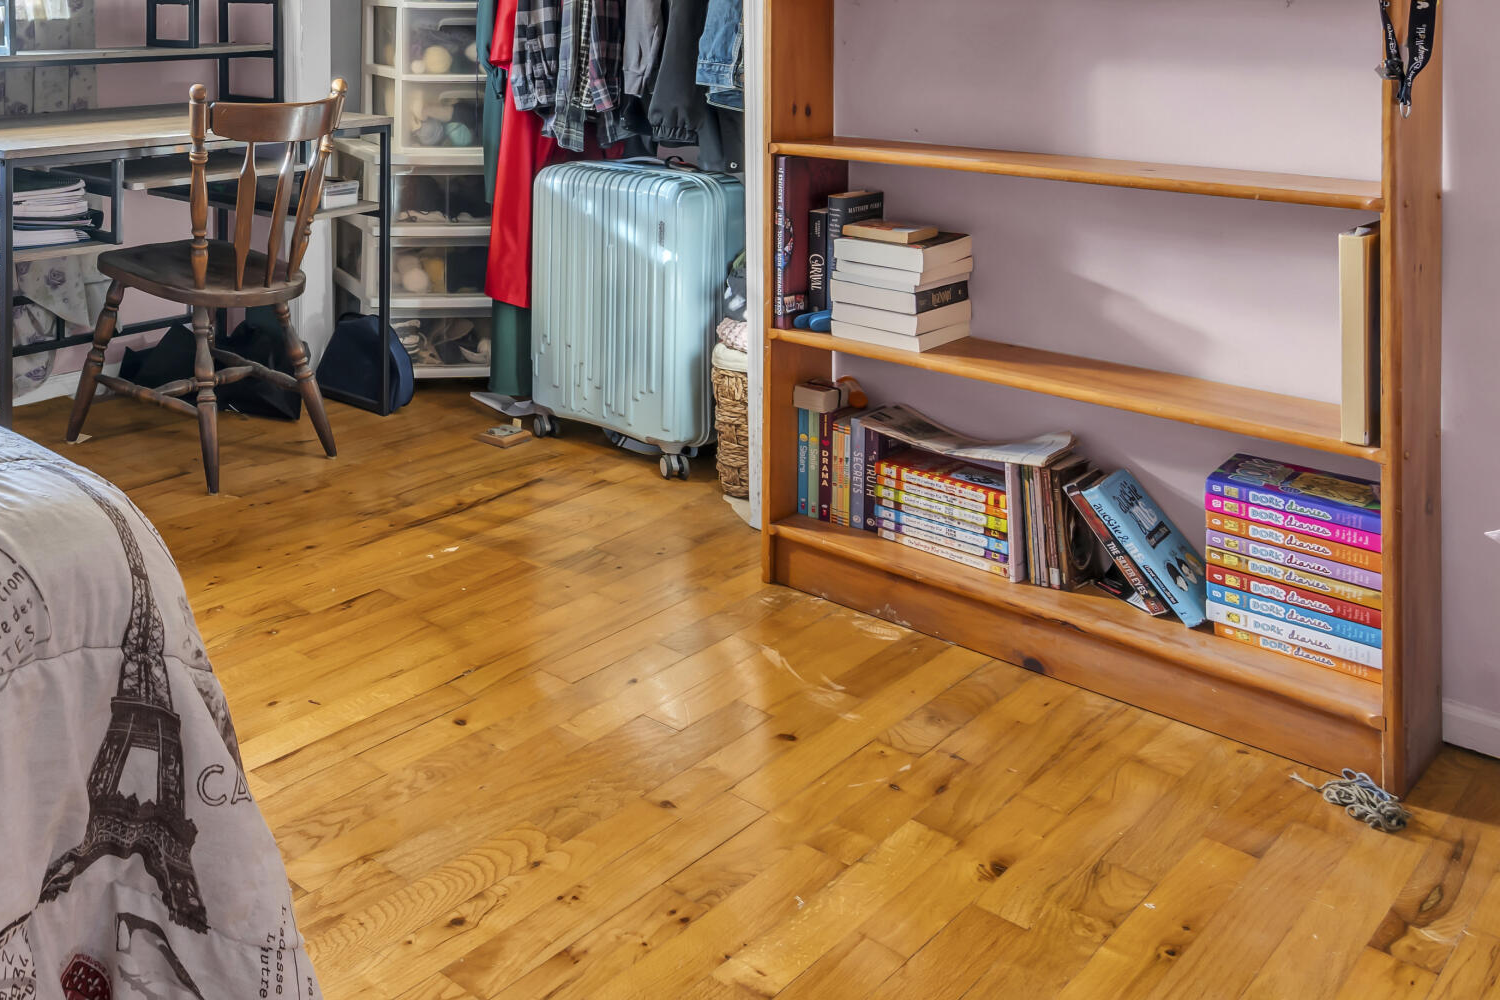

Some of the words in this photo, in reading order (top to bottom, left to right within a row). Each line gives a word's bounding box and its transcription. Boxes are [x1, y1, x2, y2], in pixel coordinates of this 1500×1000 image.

[848, 204, 869, 213] MATTHEW
[852, 451, 863, 494] SECRETS
[866, 463, 878, 498] TRUTH
[1251, 493, 1283, 508] DORK
[1286, 501, 1331, 520] diaries
[1250, 508, 1283, 524] DORK
[1285, 516, 1331, 536] diaries
[1251, 527, 1283, 543] DORK
[1285, 536, 1331, 556] diaries
[1107, 542, 1118, 556] THE
[1116, 554, 1133, 578] SILVER
[1132, 575, 1148, 595] EYES
[1251, 545, 1283, 561] DORK
[1286, 555, 1330, 574] diaries
[1250, 562, 1282, 577] DORK
[1285, 571, 1330, 591] diaries
[1252, 583, 1285, 600] DORK
[1287, 592, 1333, 612] diaries
[1251, 599, 1284, 617] DORK
[1286, 610, 1332, 630] diaries
[1253, 620, 1284, 636] DORK
[1289, 631, 1332, 650] diaries
[1261, 638, 1291, 653] DORK
[1293, 648, 1335, 667] diaries
